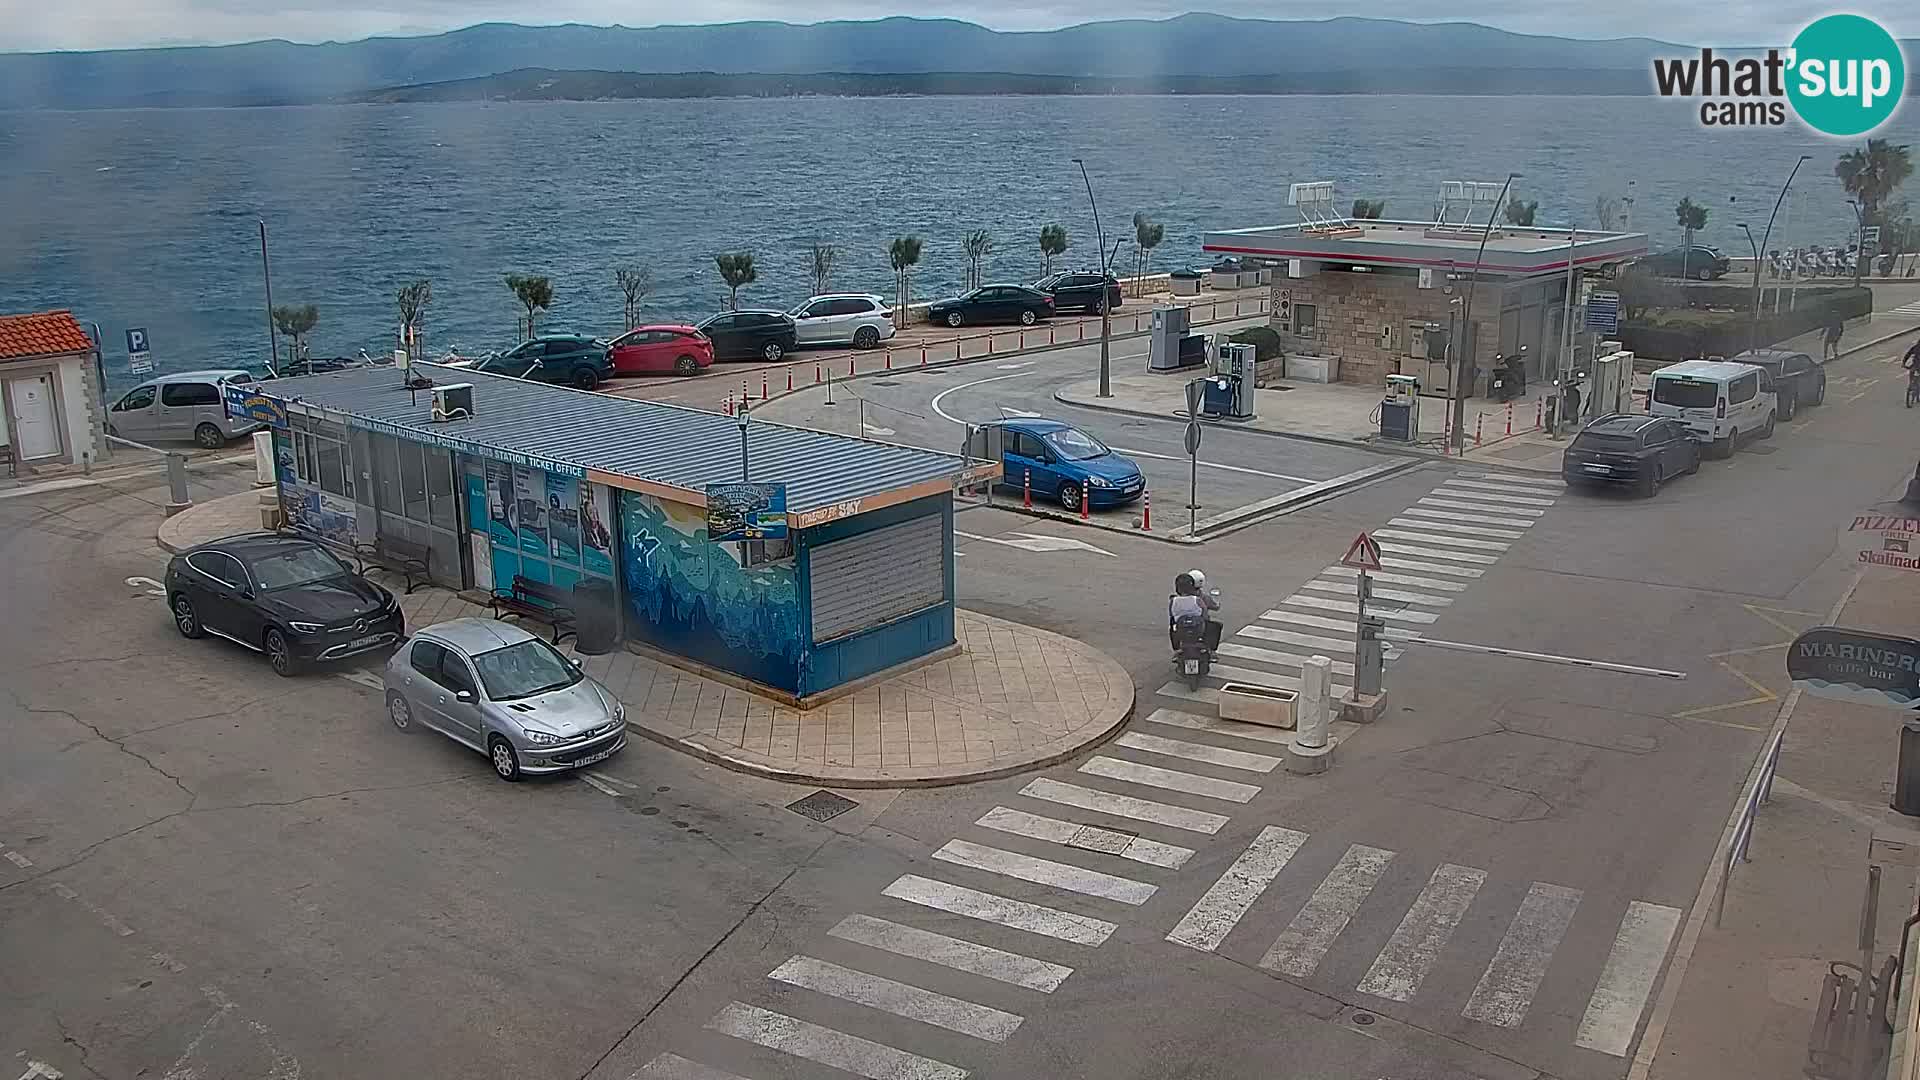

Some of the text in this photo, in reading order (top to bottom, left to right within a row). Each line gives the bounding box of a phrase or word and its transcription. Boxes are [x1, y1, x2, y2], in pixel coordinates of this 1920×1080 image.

[131, 331, 144, 350] P
[396, 428, 437, 445] AUTOBUSNA
[437, 436, 468, 451] POSTAJA
[478, 446, 493, 457] BUS
[494, 450, 526, 465] STATION
[528, 456, 555, 472] TICKET
[555, 463, 583, 478] OFFICE
[1848, 515, 1920, 534] PIZZE
[1869, 667, 1896, 681] bar
